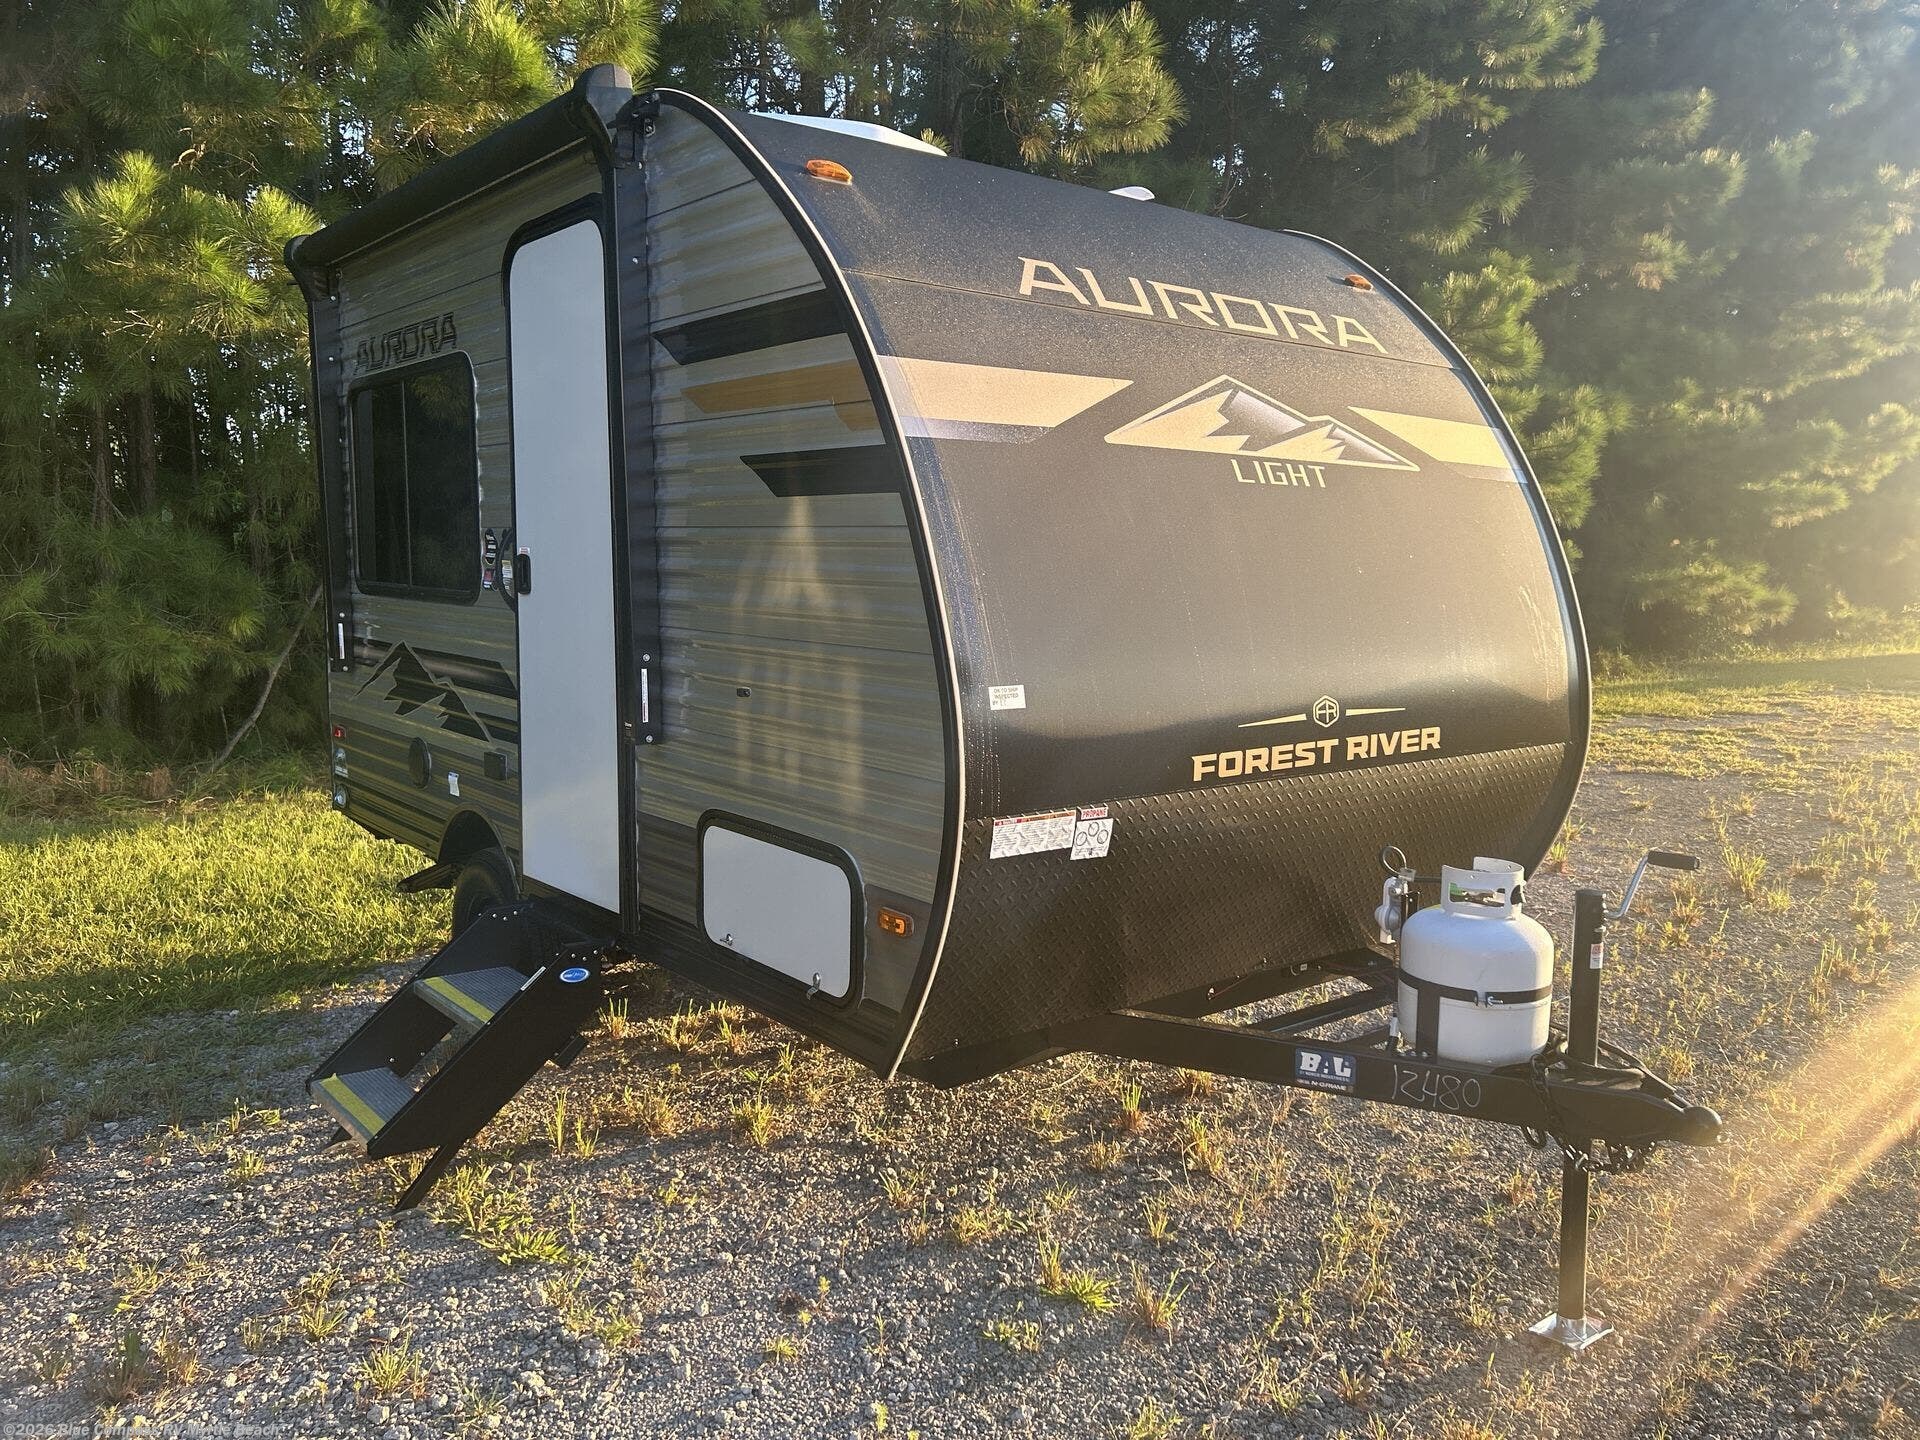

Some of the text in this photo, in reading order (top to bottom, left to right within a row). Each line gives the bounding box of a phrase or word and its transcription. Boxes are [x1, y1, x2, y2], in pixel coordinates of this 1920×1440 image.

[1018, 257, 1389, 354] AURORA
[353, 312, 457, 376] AURORA
[1230, 458, 1327, 488] LIGHT
[1191, 726, 1442, 782] FOREST RIVER
[1082, 808, 1107, 819] PROPANE
[1391, 1064, 1481, 1110] 12480
